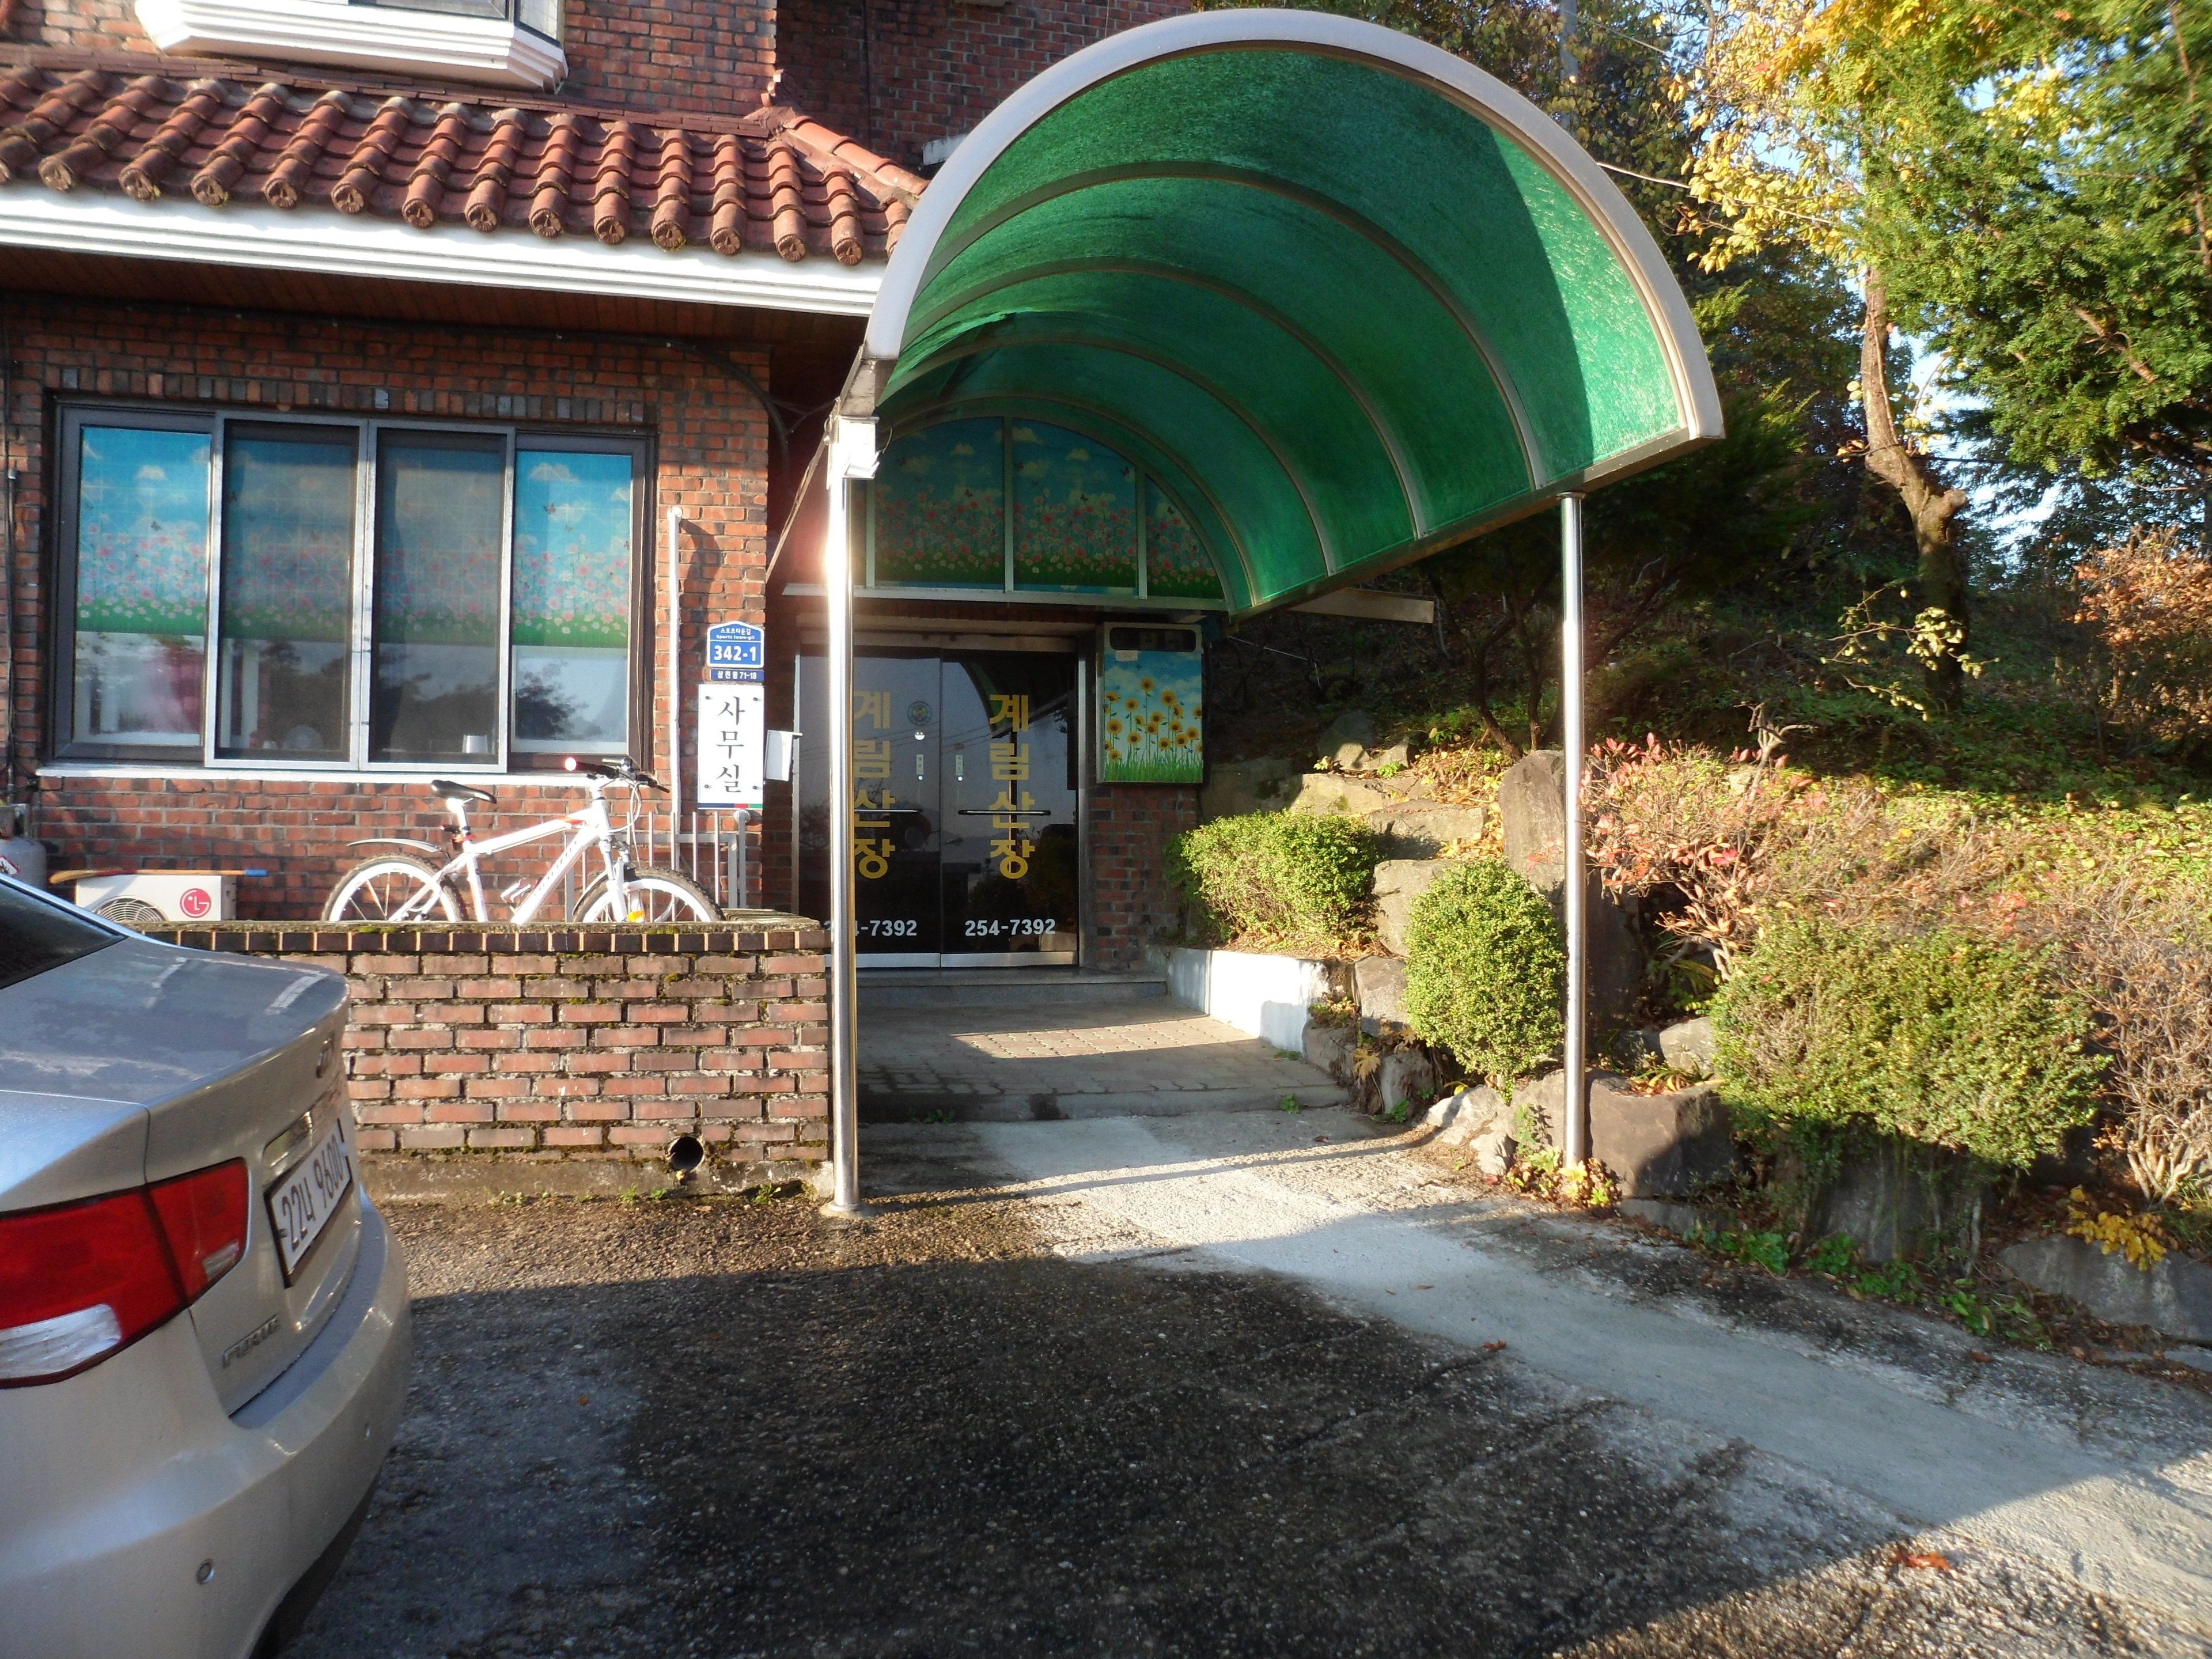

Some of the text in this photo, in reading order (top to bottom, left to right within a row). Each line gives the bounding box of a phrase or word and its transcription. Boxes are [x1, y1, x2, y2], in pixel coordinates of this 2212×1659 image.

[720, 627, 751, 635] 스포츠타운길
[714, 645, 756, 661] 342-1
[739, 672, 757, 680] 71-18
[716, 696, 745, 793] 사무실
[989, 694, 1036, 879] 계림산장
[180, 888, 212, 919] LG
[823, 919, 918, 937] -7392
[964, 918, 1056, 936] 254-7392
[313, 1134, 344, 1209] 9600
